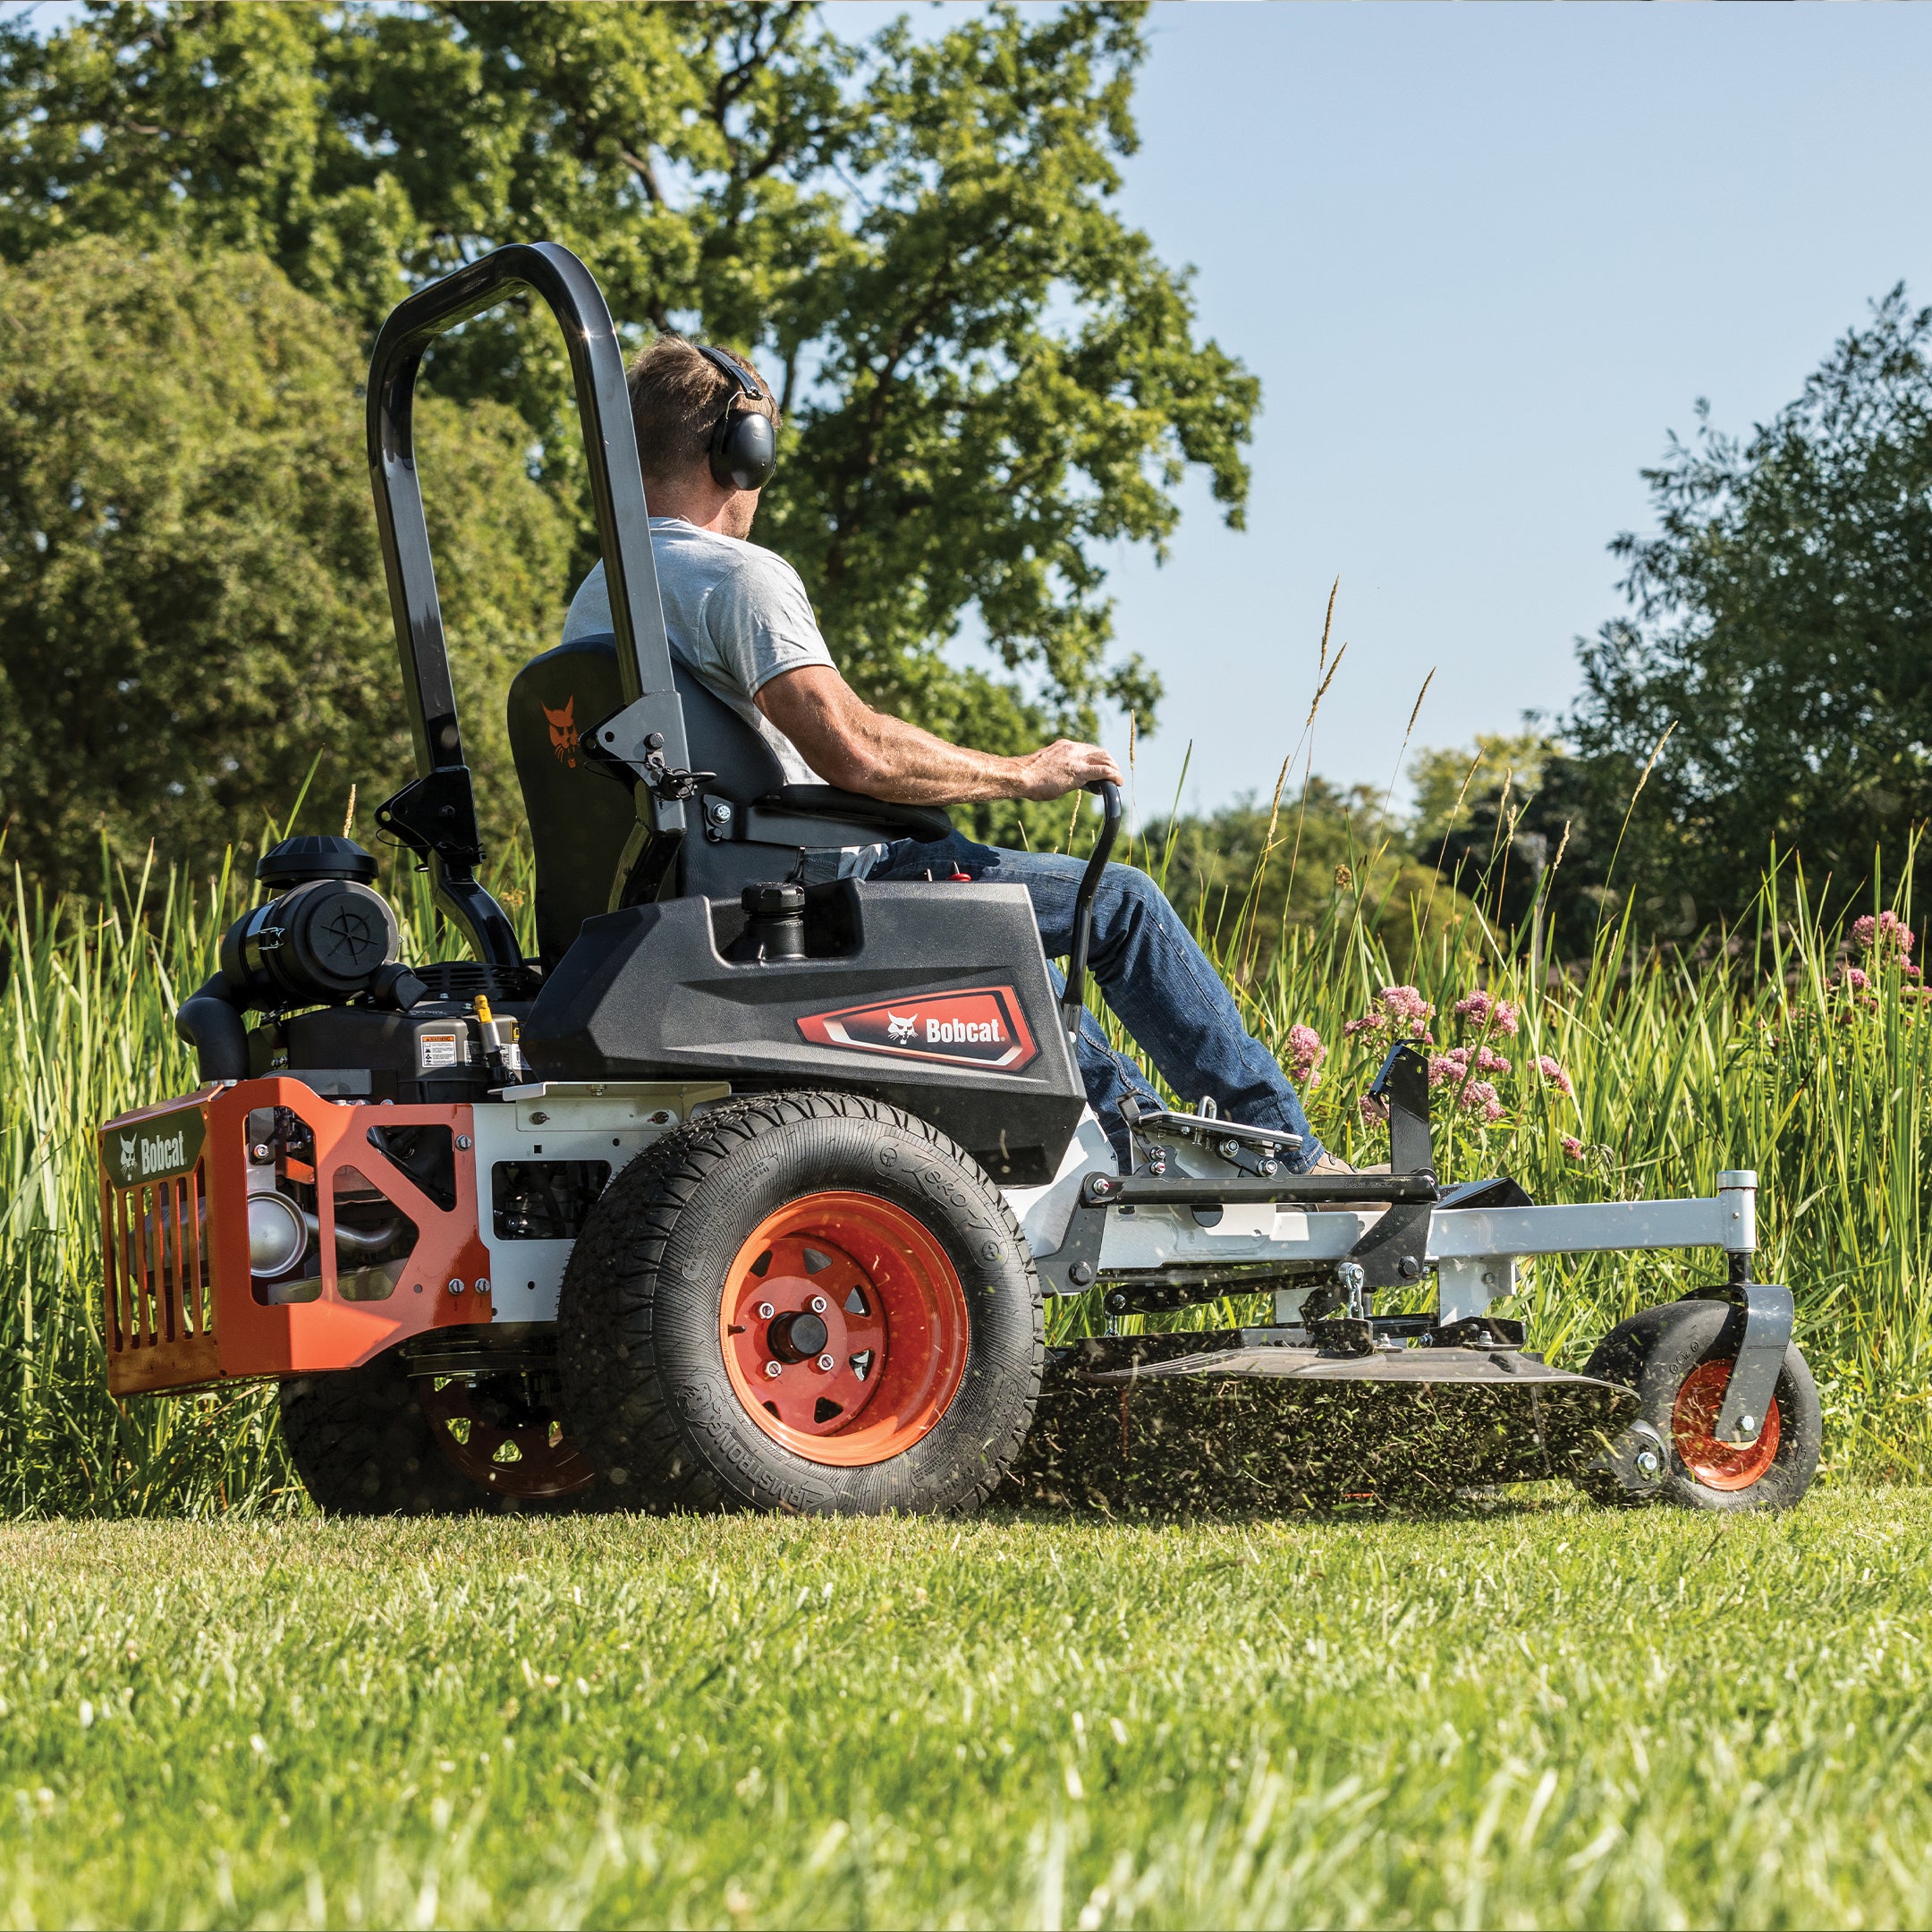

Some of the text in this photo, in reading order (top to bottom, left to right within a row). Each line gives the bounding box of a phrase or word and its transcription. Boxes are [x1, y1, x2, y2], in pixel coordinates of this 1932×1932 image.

[926, 1018, 1000, 1043] Bobcat
[140, 1131, 184, 1175] Bobcat
[705, 1420, 835, 1512] ARMSTRONG
